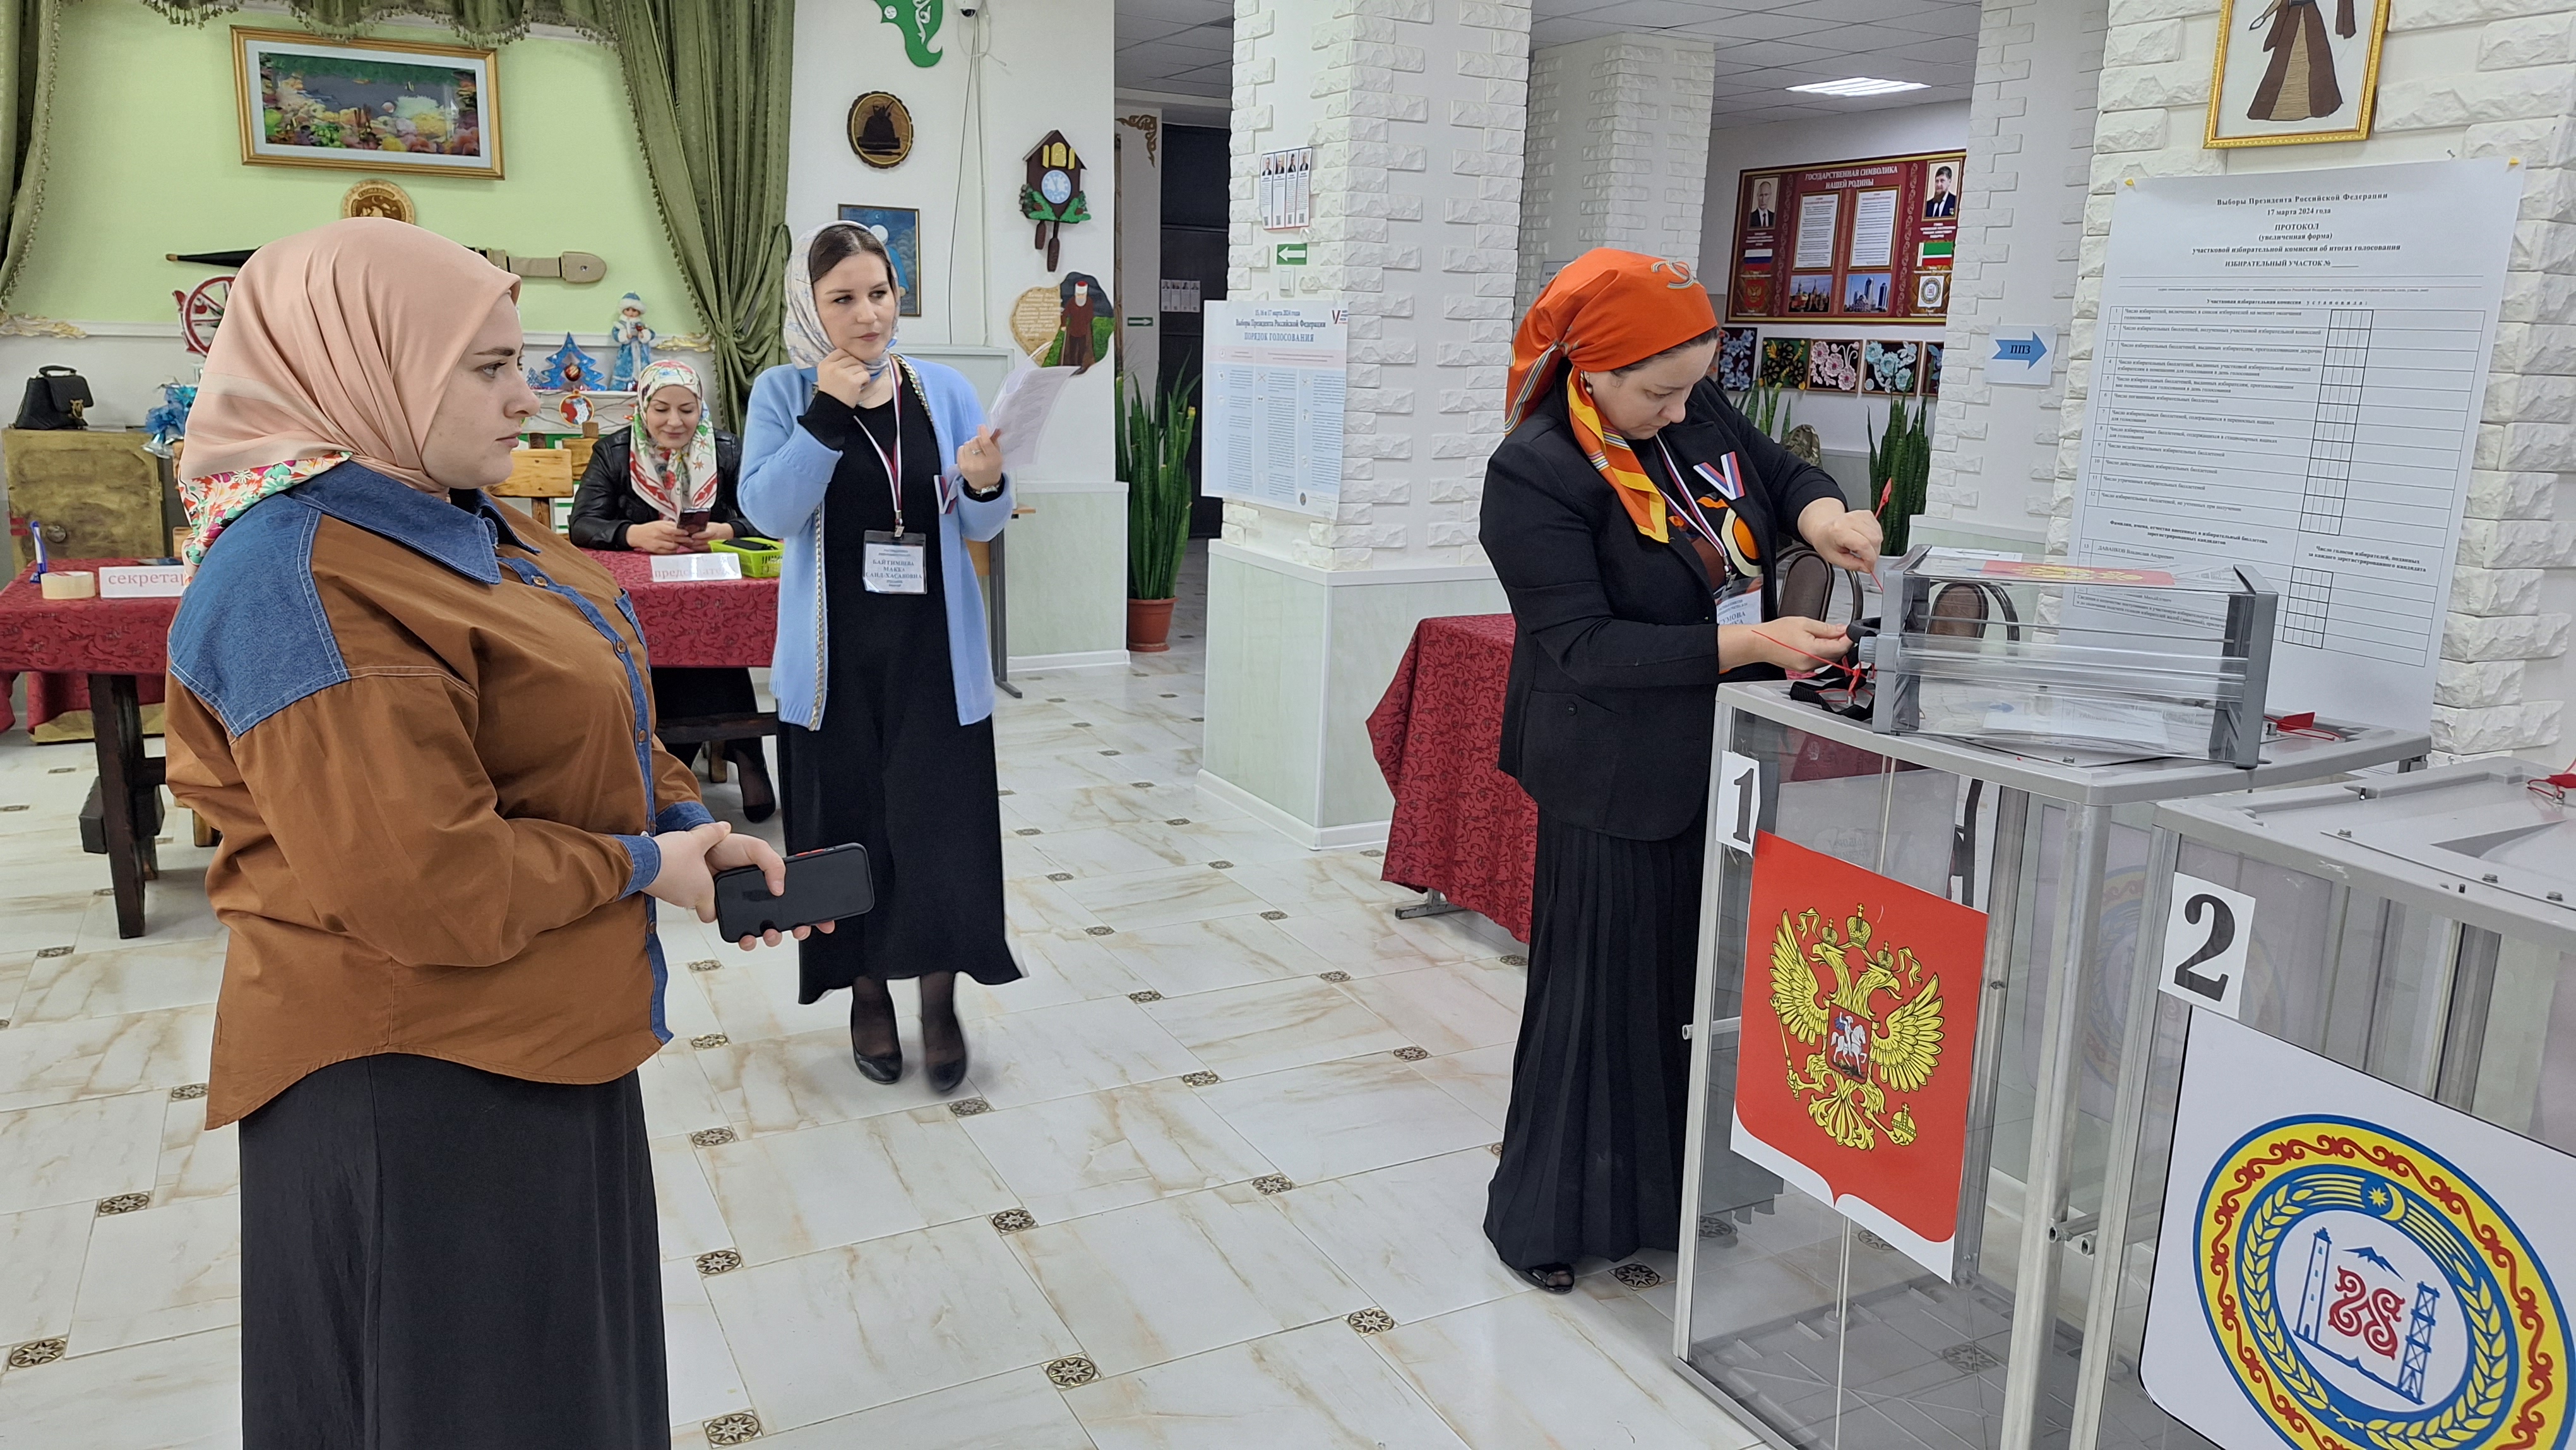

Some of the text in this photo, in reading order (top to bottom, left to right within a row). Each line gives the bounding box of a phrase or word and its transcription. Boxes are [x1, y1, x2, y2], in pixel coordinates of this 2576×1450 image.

[1804, 165, 1898, 181] ГОСУДАРСТВЕННАЯ СИМВОЛИКА
[1825, 178, 1874, 189] НАШЕЙ РОДИНЫ
[2249, 197, 2292, 205] Президента
[2294, 194, 2340, 202] Российской
[2342, 193, 2388, 201] Федерации
[2274, 223, 2320, 231] ПРОТОКОЛ
[2307, 232, 2333, 241] форма)
[2231, 246, 2282, 254] избирательной
[1244, 332, 1315, 342] ПОРЯДОК ГОЛОСОВАНИЯ
[2010, 345, 2031, 354] ППЗ
[1732, 767, 1754, 844] 1
[2174, 894, 2236, 1002] 2
